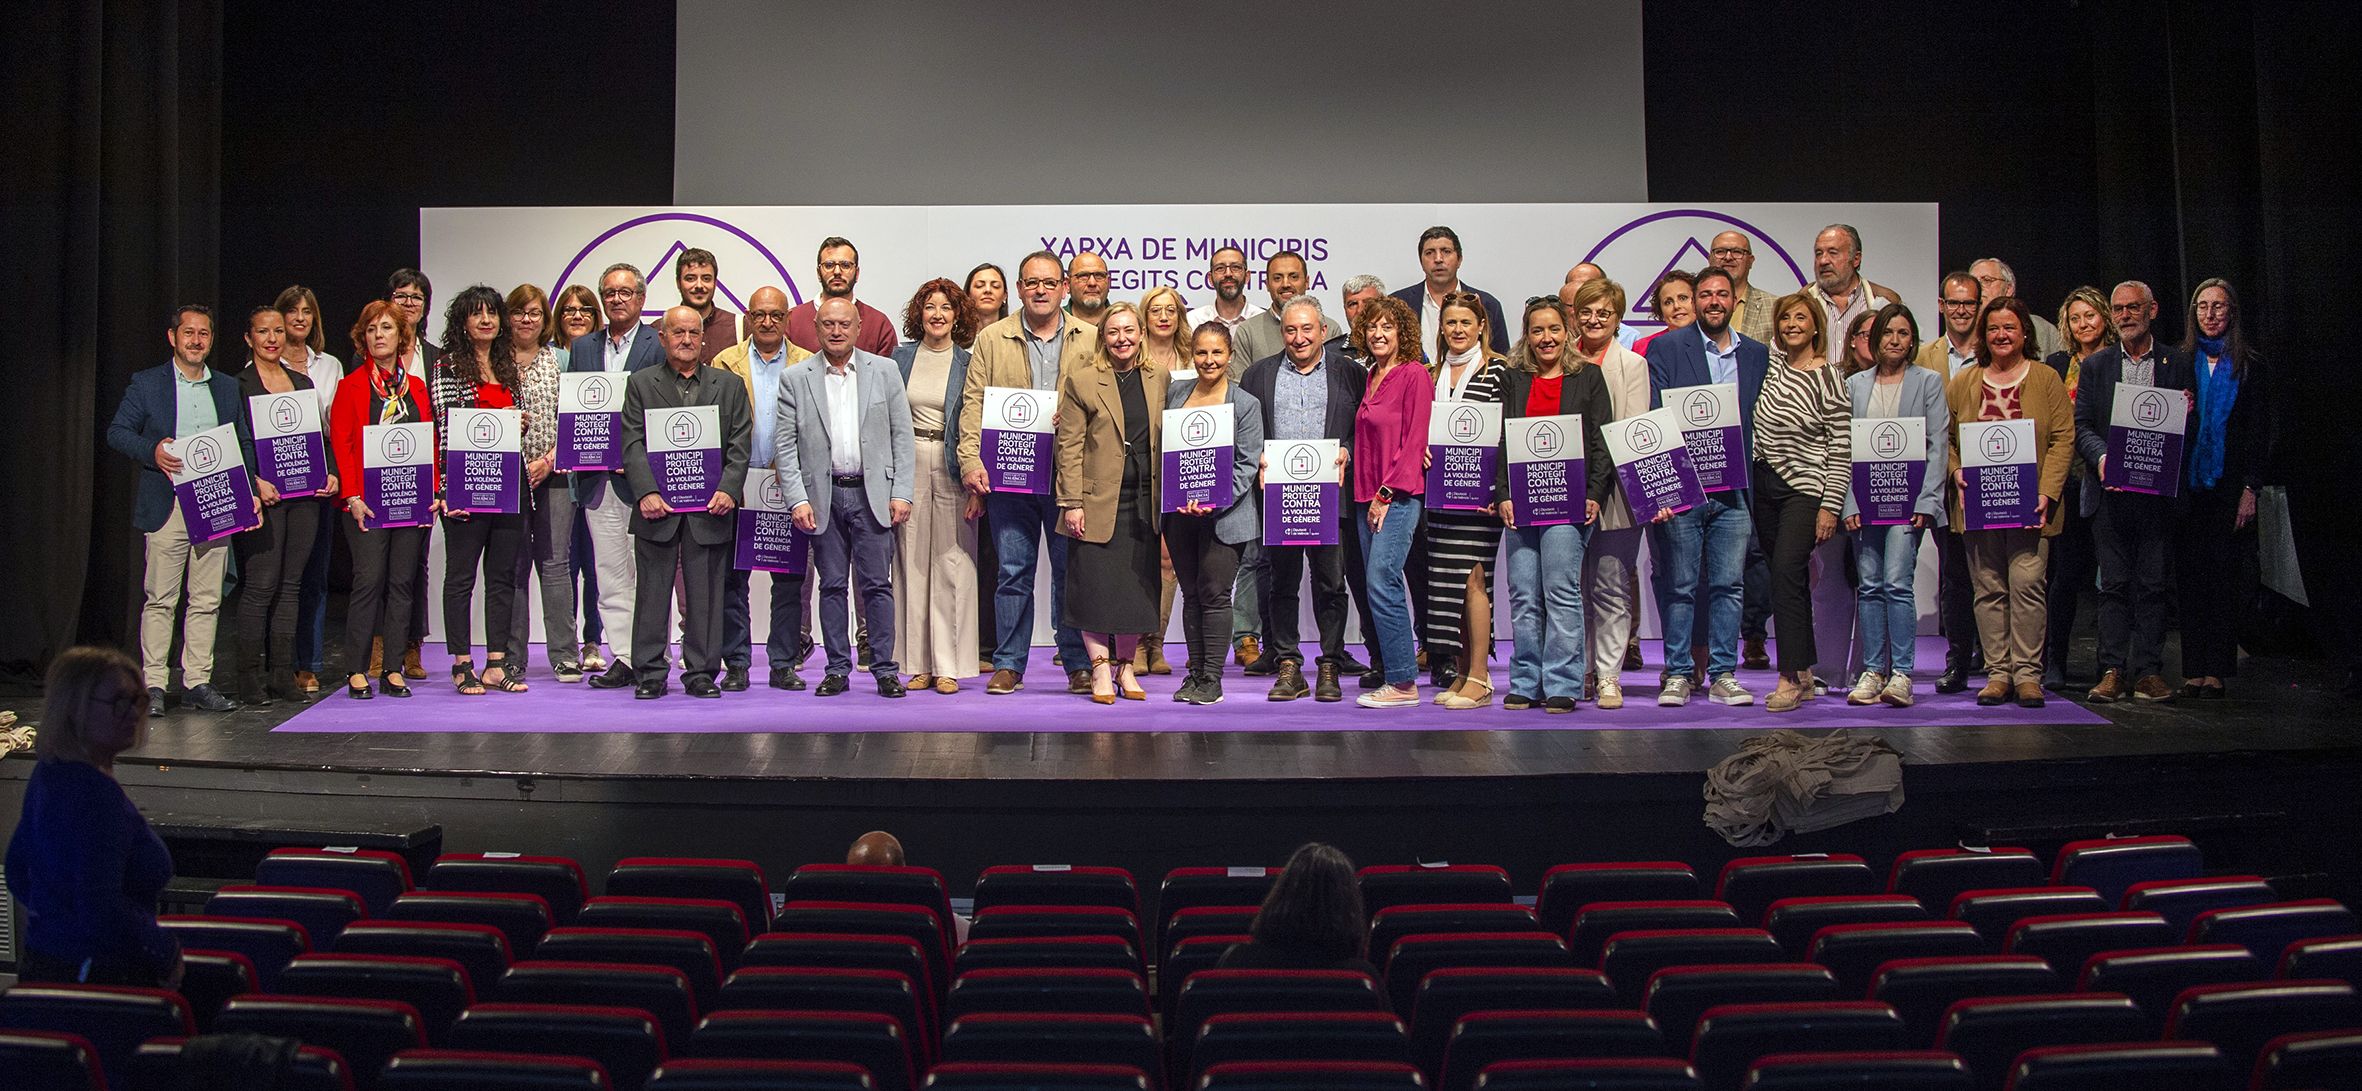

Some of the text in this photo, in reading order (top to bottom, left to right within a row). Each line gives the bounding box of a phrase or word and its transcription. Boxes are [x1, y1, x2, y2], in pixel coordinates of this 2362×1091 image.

[1040, 236, 1133, 260] XARXA
[1142, 238, 1176, 260] DE
[999, 432, 1036, 441] MUNICIPI
[1685, 430, 1724, 440] MUNICIPI
[2127, 430, 2165, 442] MUNICIPI
[272, 435, 306, 447] MUNICIPI
[998, 440, 1036, 448] PROTEGIT
[1686, 438, 1725, 448] PROTEGIT
[2126, 438, 2164, 449] PROTEGIT
[273, 443, 307, 454] PROTEGIT
[998, 447, 1035, 456] CONTRA
[1688, 445, 1725, 456] CONTRA
[2125, 445, 2163, 457] CONTRA
[274, 450, 308, 462] CONTRA
[666, 451, 703, 461] MUNICIPI
[1180, 449, 1215, 459] MUNICIPI
[666, 459, 704, 468] PROTEGIT
[1180, 457, 1215, 467] PROTEGIT
[1634, 452, 1672, 470] MUNICIPI
[381, 467, 416, 476] MUNICIPI
[666, 466, 704, 476] CONTRA
[1180, 464, 1215, 475] CONTRA
[1445, 463, 1481, 471] CONTRA
[1527, 462, 1566, 472] MUNICIPI
[1637, 460, 1675, 477] PROTEGIT
[1980, 466, 2018, 476] MUNICIPI
[381, 475, 416, 484] PROTEGIT
[1527, 470, 1566, 479] PROTEGIT
[1639, 466, 1678, 484] CONTRA
[1981, 474, 2019, 483] PROTEGIT
[192, 472, 229, 490] MUNICIPI
[1528, 477, 1567, 488] CONTRA
[1870, 478, 1908, 487] CONTRA
[1981, 481, 2019, 491] CONTRA
[194, 480, 231, 497] PROTEGIT
[381, 482, 417, 492] CONTRA
[196, 487, 233, 505] CONTRA
[1645, 490, 1655, 498] DE
[200, 510, 210, 519] DE
[756, 520, 792, 529] PROTEGIT
[755, 527, 791, 537] CONTRA
